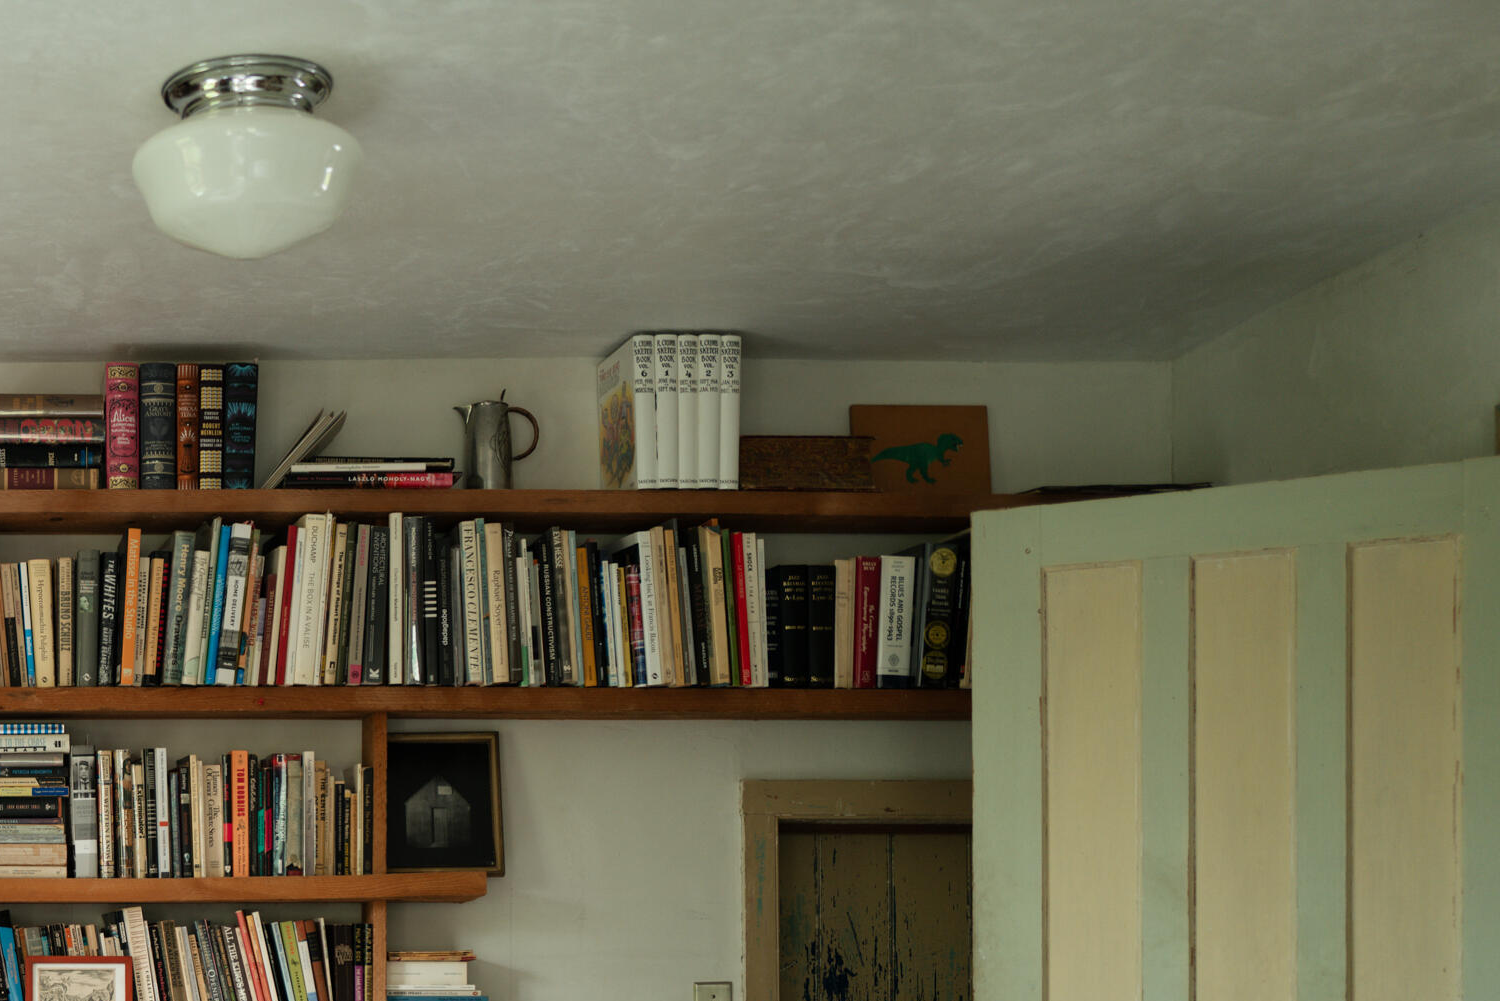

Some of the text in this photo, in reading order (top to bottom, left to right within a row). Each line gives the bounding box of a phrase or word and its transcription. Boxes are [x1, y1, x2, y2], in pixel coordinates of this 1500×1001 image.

[309, 525, 319, 564] DUCHAMP
[372, 532, 380, 574] INVENTIONS
[378, 532, 387, 586] ARCHITECTURAL
[552, 531, 563, 569] EVA HESSE
[746, 553, 754, 572] SHOCK
[105, 560, 116, 573] THE
[307, 572, 315, 586] THE
[335, 567, 343, 590] Writings
[643, 555, 653, 583] Looking
[61, 591, 71, 619] BRUNO
[102, 574, 117, 620] WHITES
[124, 539, 139, 640] Matisse in the Studio
[170, 544, 190, 666] Henry Moore Drawings
[229, 580, 240, 627] HOME DELIVERY
[305, 588, 314, 604] BOX
[463, 528, 479, 671] FRANCESCO CLEMENTE
[492, 570, 504, 627] Raphael Soyer
[543, 564, 556, 661] RUSSIAN CONSTRUCTIVISM
[647, 607, 656, 631] Francis
[887, 576, 897, 641] RECORDS 1890-1943
[895, 576, 905, 641] BLUES AND GOSPEL
[61, 622, 72, 652] SCHULZ
[302, 623, 312, 649] VALISE
[440, 609, 448, 646] dadaglobe
[649, 633, 657, 654] Bacon
[237, 768, 245, 817] TOM ROBBINS
[223, 925, 233, 943] ALL
[227, 944, 237, 960] THE
